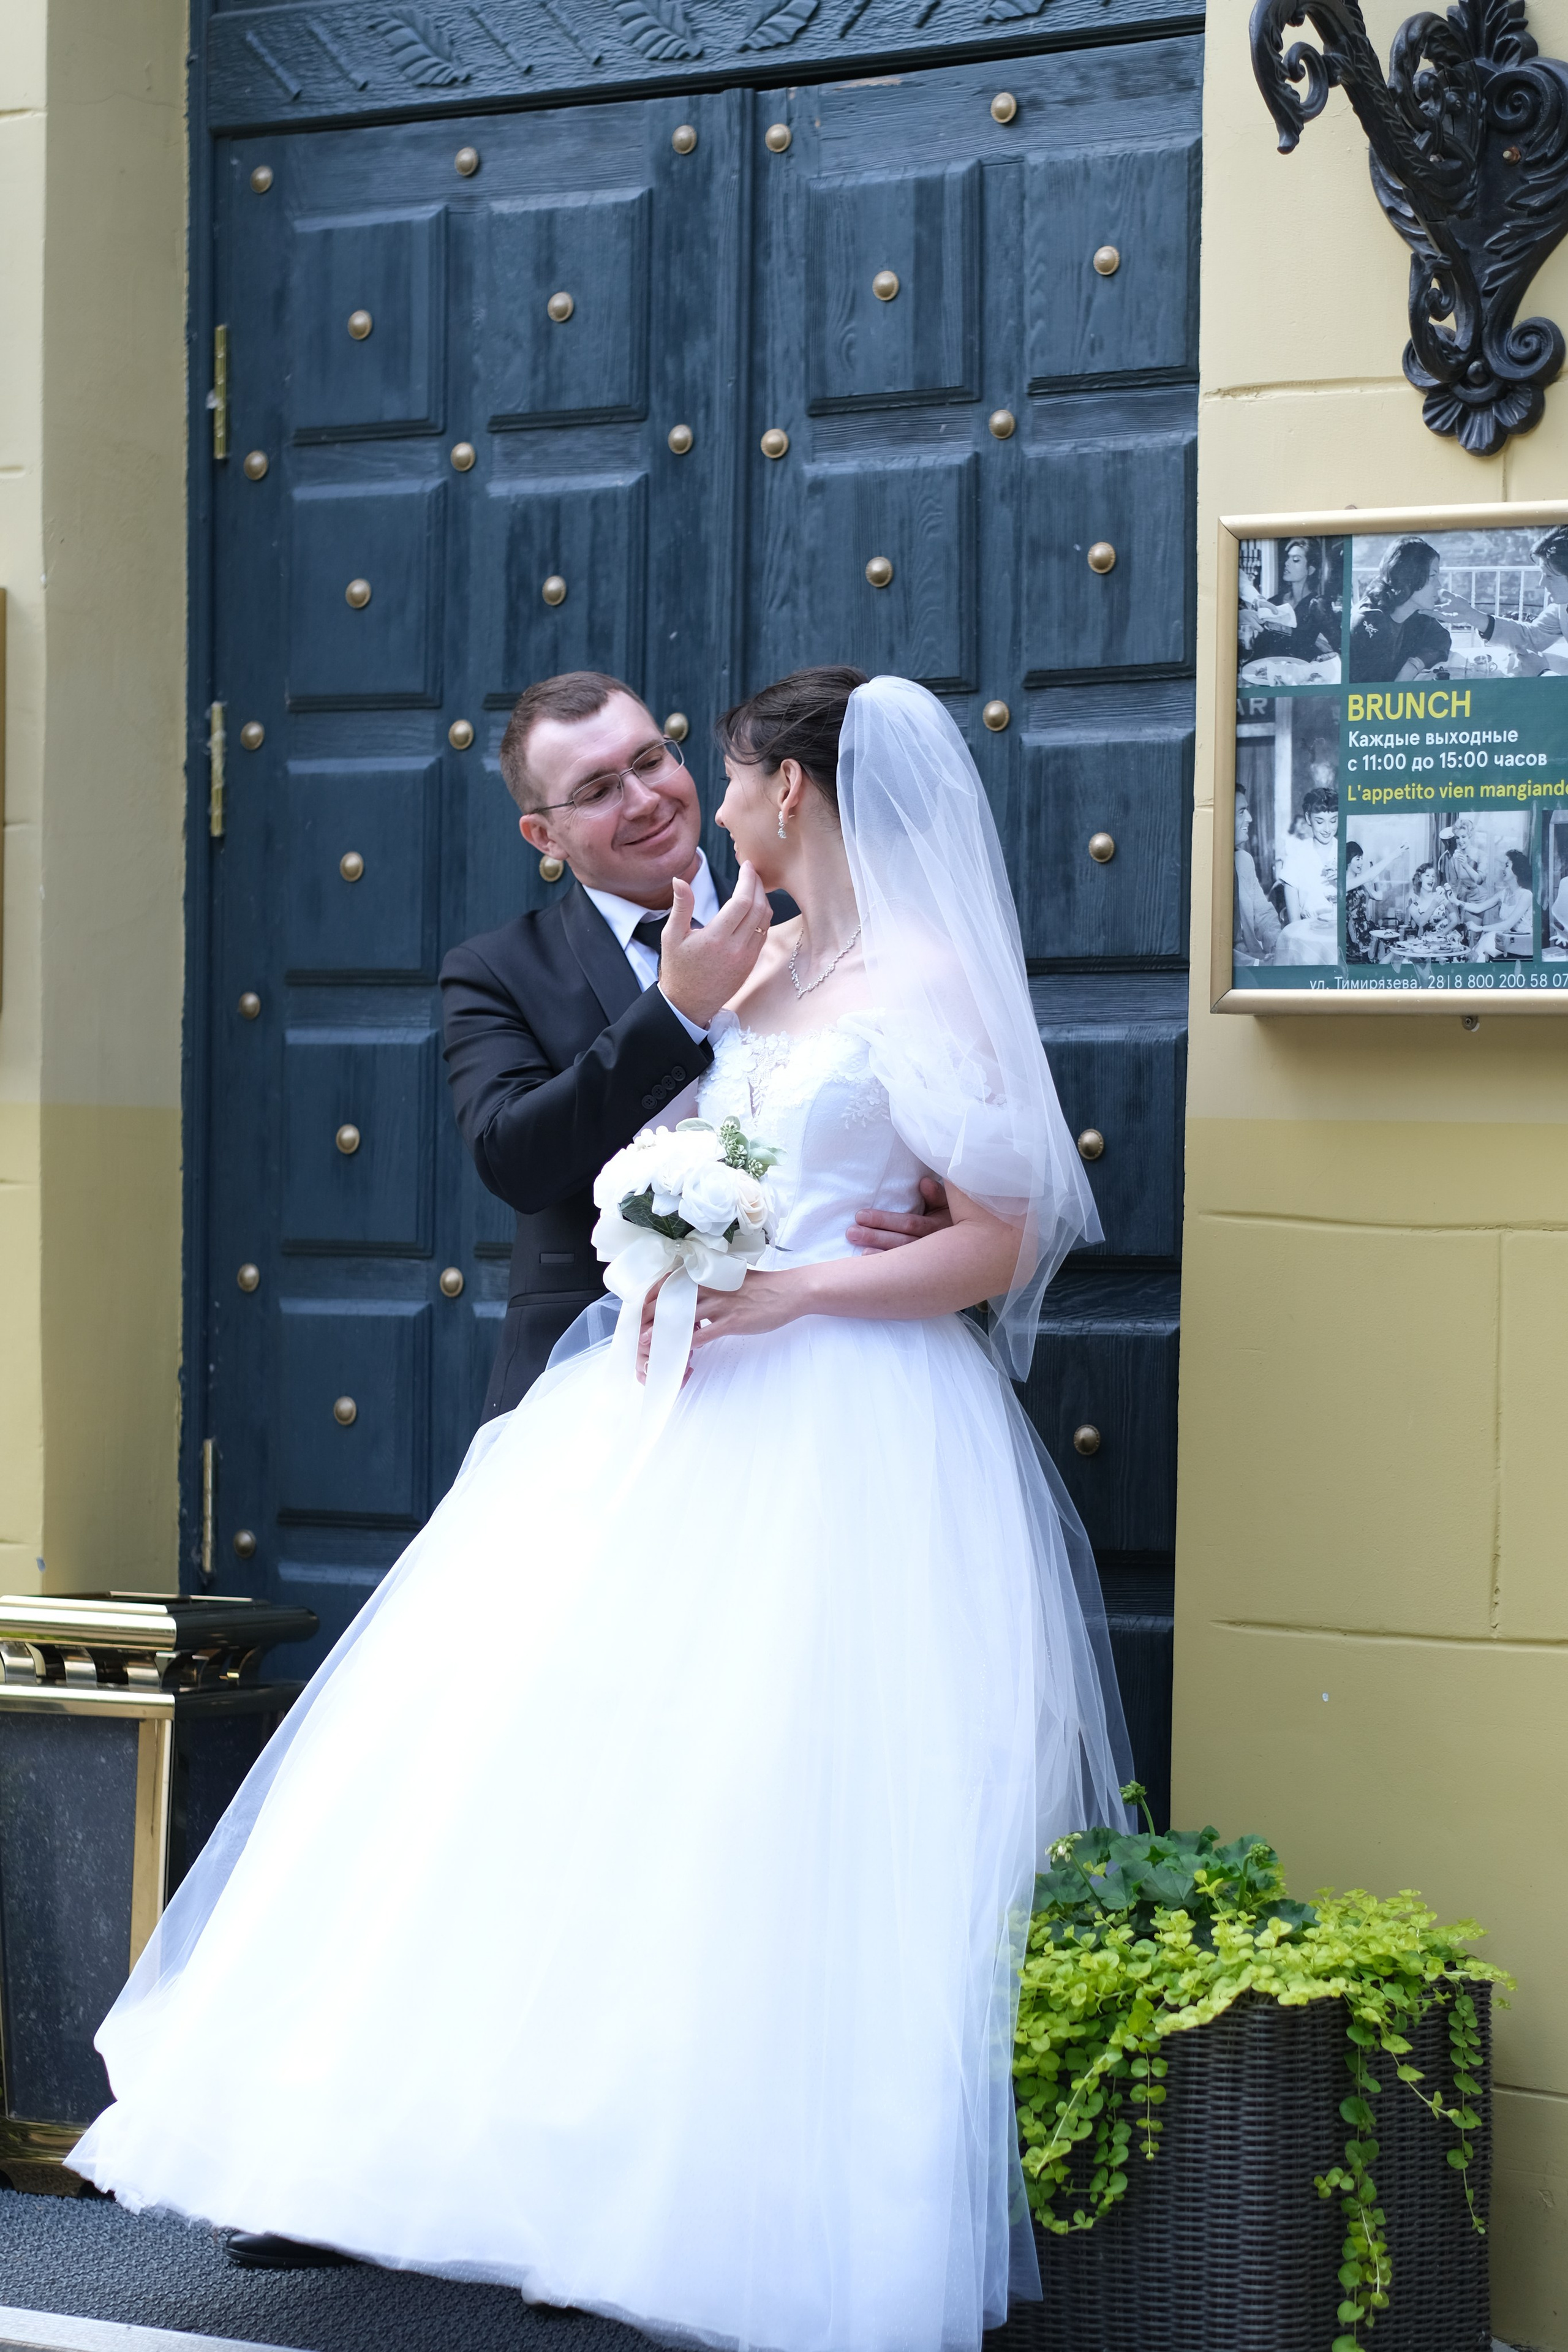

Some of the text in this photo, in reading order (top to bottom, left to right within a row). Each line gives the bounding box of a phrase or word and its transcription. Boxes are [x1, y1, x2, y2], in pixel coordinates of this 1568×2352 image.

[1348, 690, 1471, 722] BRUNCH
[1348, 729, 1519, 748] Каждые выходные
[1348, 750, 1548, 772] с 11:00 до 15:00 часов
[1348, 779, 1568, 805] L'appetito vien mangiand
[1334, 976, 1422, 990] Тимирязева,
[1468, 974, 1494, 989] 800
[1499, 973, 1525, 988] 200
[1530, 973, 1547, 987] 58
